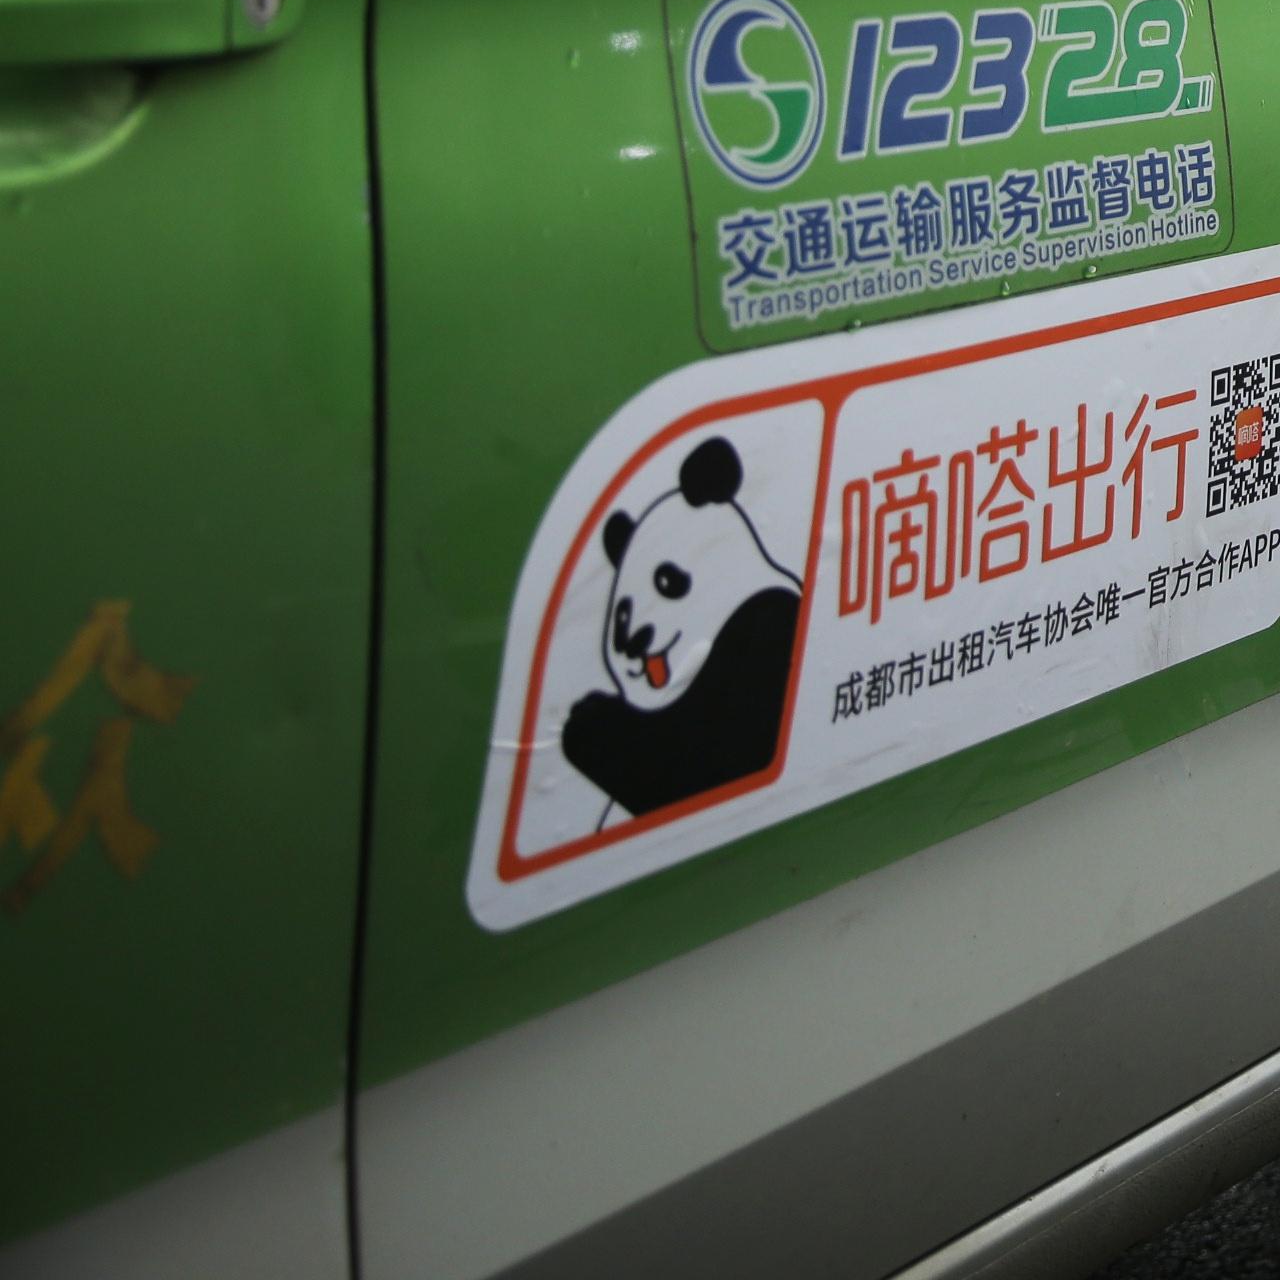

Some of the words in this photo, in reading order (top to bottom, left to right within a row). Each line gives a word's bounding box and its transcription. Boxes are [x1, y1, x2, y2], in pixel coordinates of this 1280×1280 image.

[723, 144, 1215, 288] 交通运输服务监督电话
[729, 269, 922, 323] Transportation
[929, 252, 1016, 285] Service
[1022, 226, 1146, 267] Supervision
[1151, 212, 1218, 241] Hotline
[838, 388, 1201, 627] 嘀嗒出行
